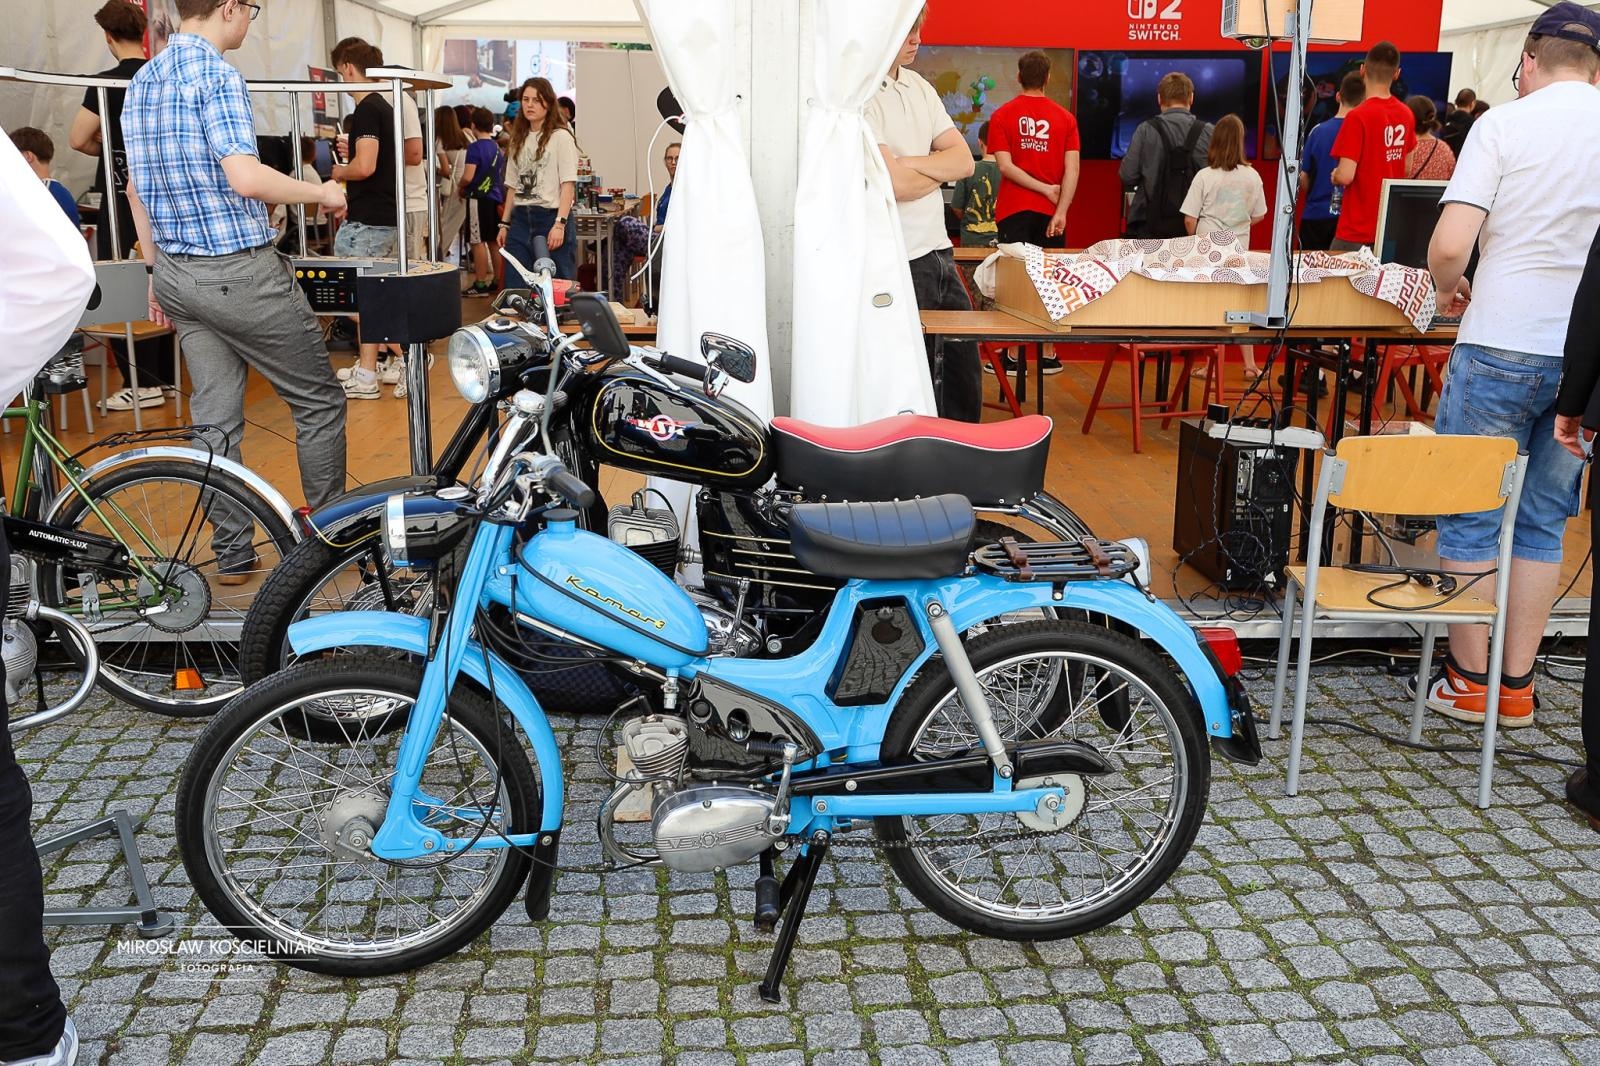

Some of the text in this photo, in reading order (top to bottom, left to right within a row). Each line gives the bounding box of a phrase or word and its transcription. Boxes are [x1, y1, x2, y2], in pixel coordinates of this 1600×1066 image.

[1128, 30, 1180, 40] SWITCH
[1035, 119, 1050, 139] 2
[1393, 124, 1405, 146] 2
[28, 529, 88, 550] AUTOMATIC-LUX
